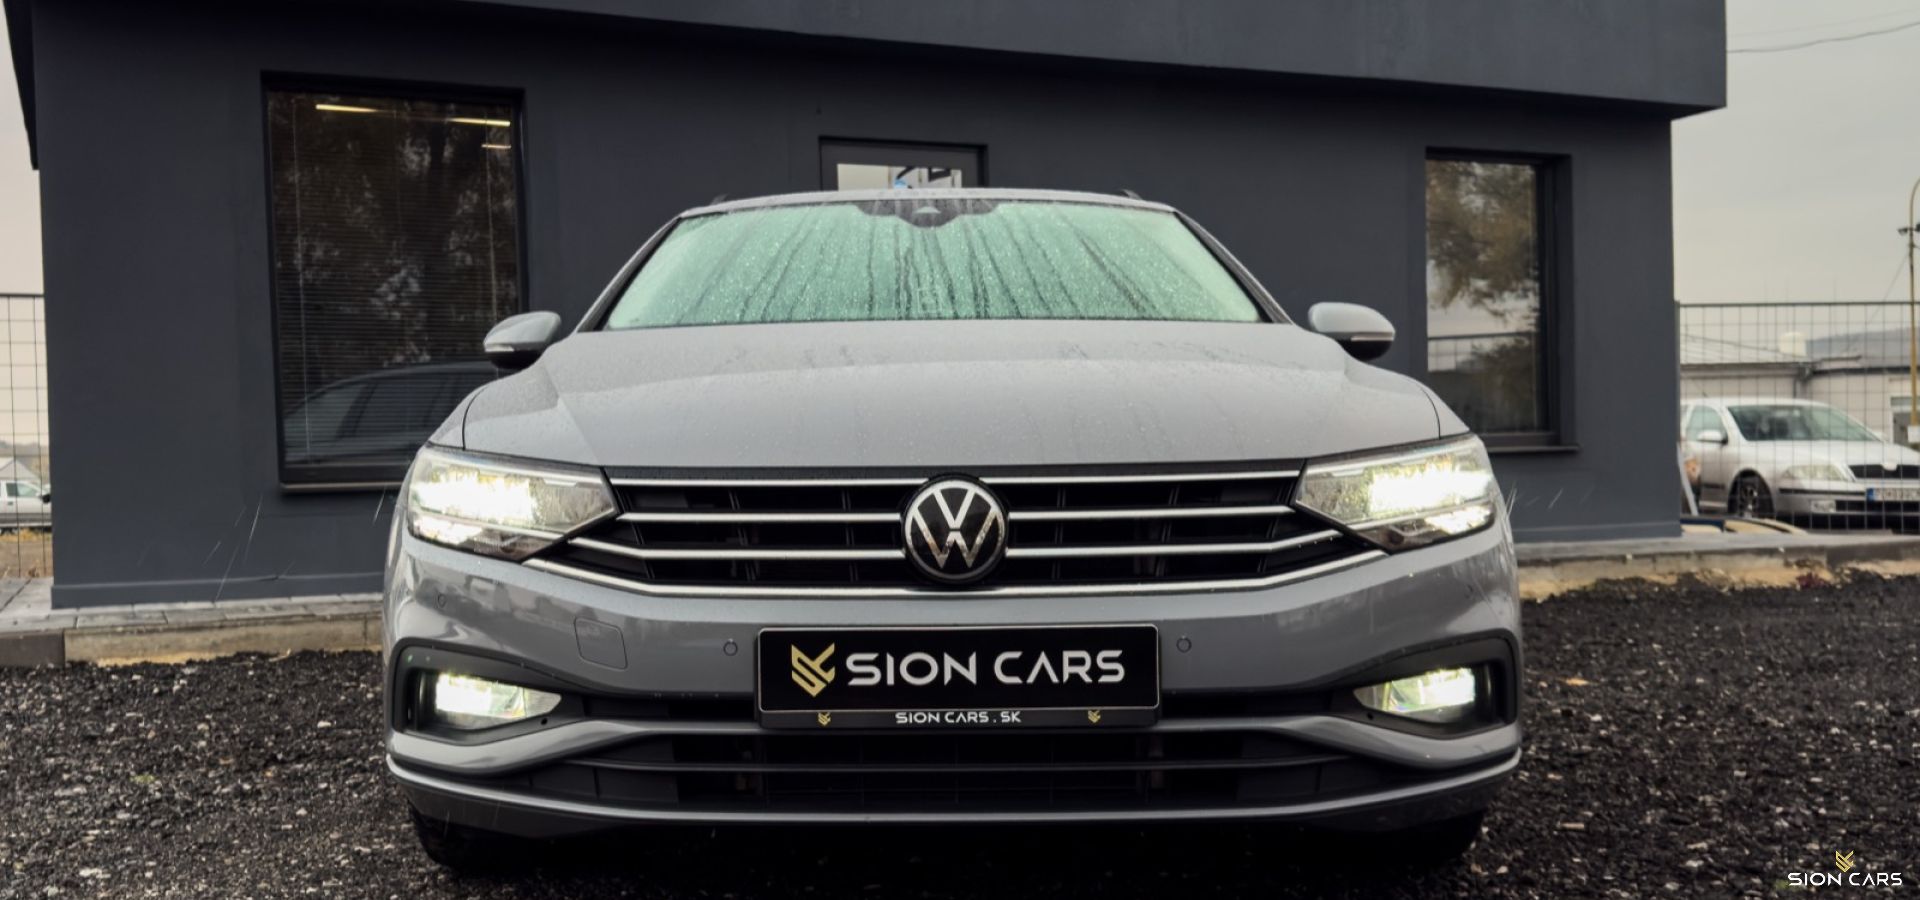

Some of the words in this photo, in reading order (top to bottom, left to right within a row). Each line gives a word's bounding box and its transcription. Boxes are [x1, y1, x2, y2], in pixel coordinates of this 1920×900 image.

[845, 652, 977, 686] SION
[993, 650, 1125, 684] CARS
[895, 711, 941, 724] SION
[944, 711, 990, 723] CARS
